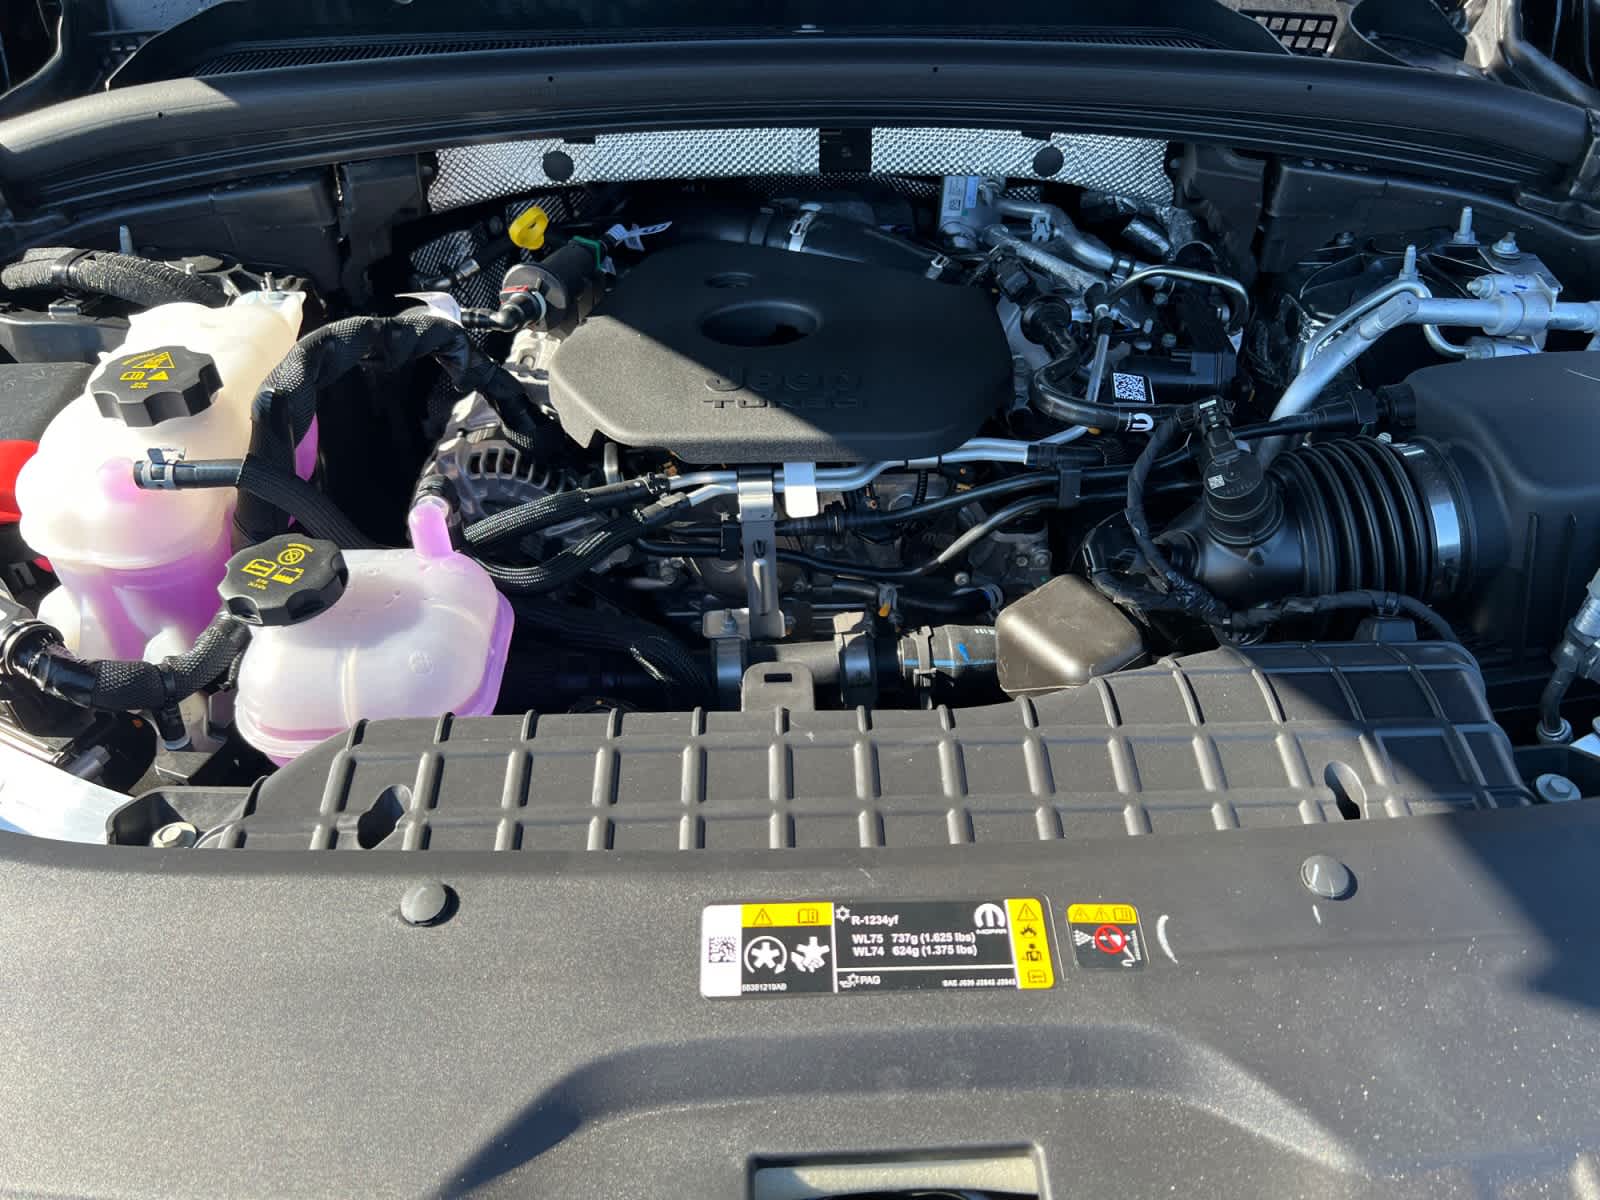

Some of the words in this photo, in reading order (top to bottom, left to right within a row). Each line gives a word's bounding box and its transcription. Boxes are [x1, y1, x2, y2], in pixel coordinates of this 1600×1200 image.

[851, 914, 900, 927] R-1234yf
[852, 933, 883, 944] WL75
[891, 933, 918, 945] 737g
[920, 932, 954, 944] (1.625
[954, 931, 976, 943] lbs)
[852, 946, 884, 957] WL74
[891, 946, 920, 958] 624g
[921, 945, 954, 957] (1.375
[955, 944, 978, 957] lbs)
[859, 975, 881, 985] PAG
